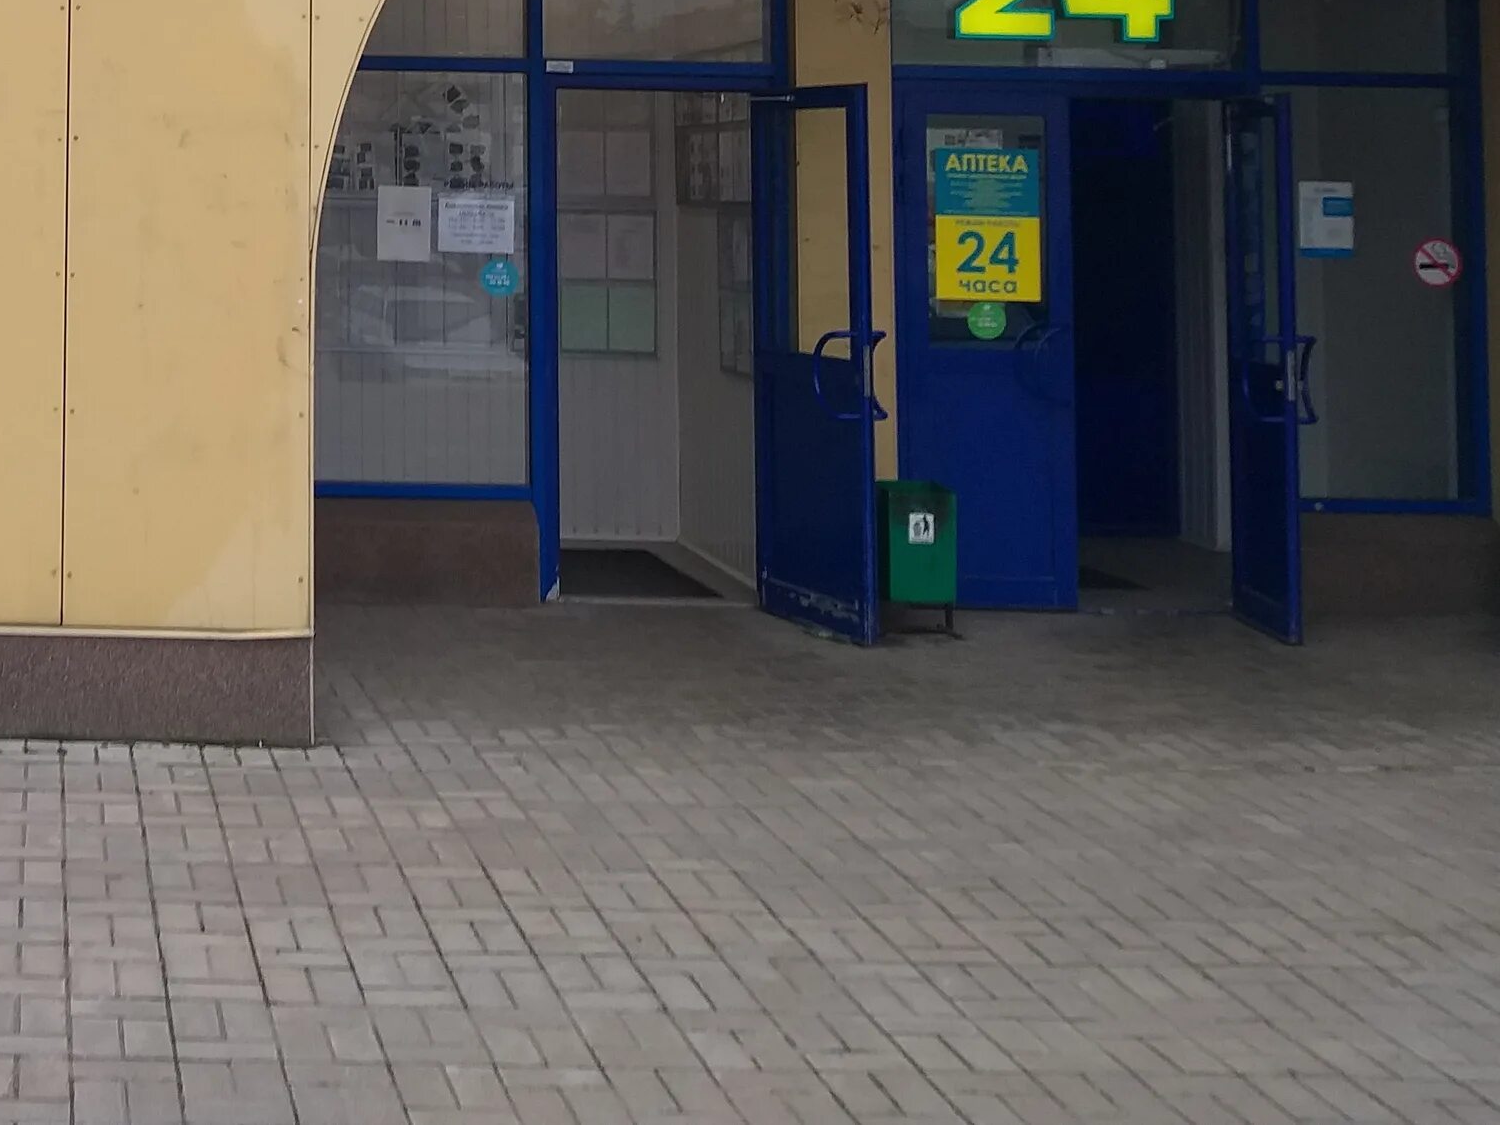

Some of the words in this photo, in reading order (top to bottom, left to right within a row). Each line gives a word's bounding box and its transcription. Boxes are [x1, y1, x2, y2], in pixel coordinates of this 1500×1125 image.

[945, 153, 1029, 173] АПТЕКА
[956, 230, 1019, 275] 24
[959, 279, 1018, 293] часа
